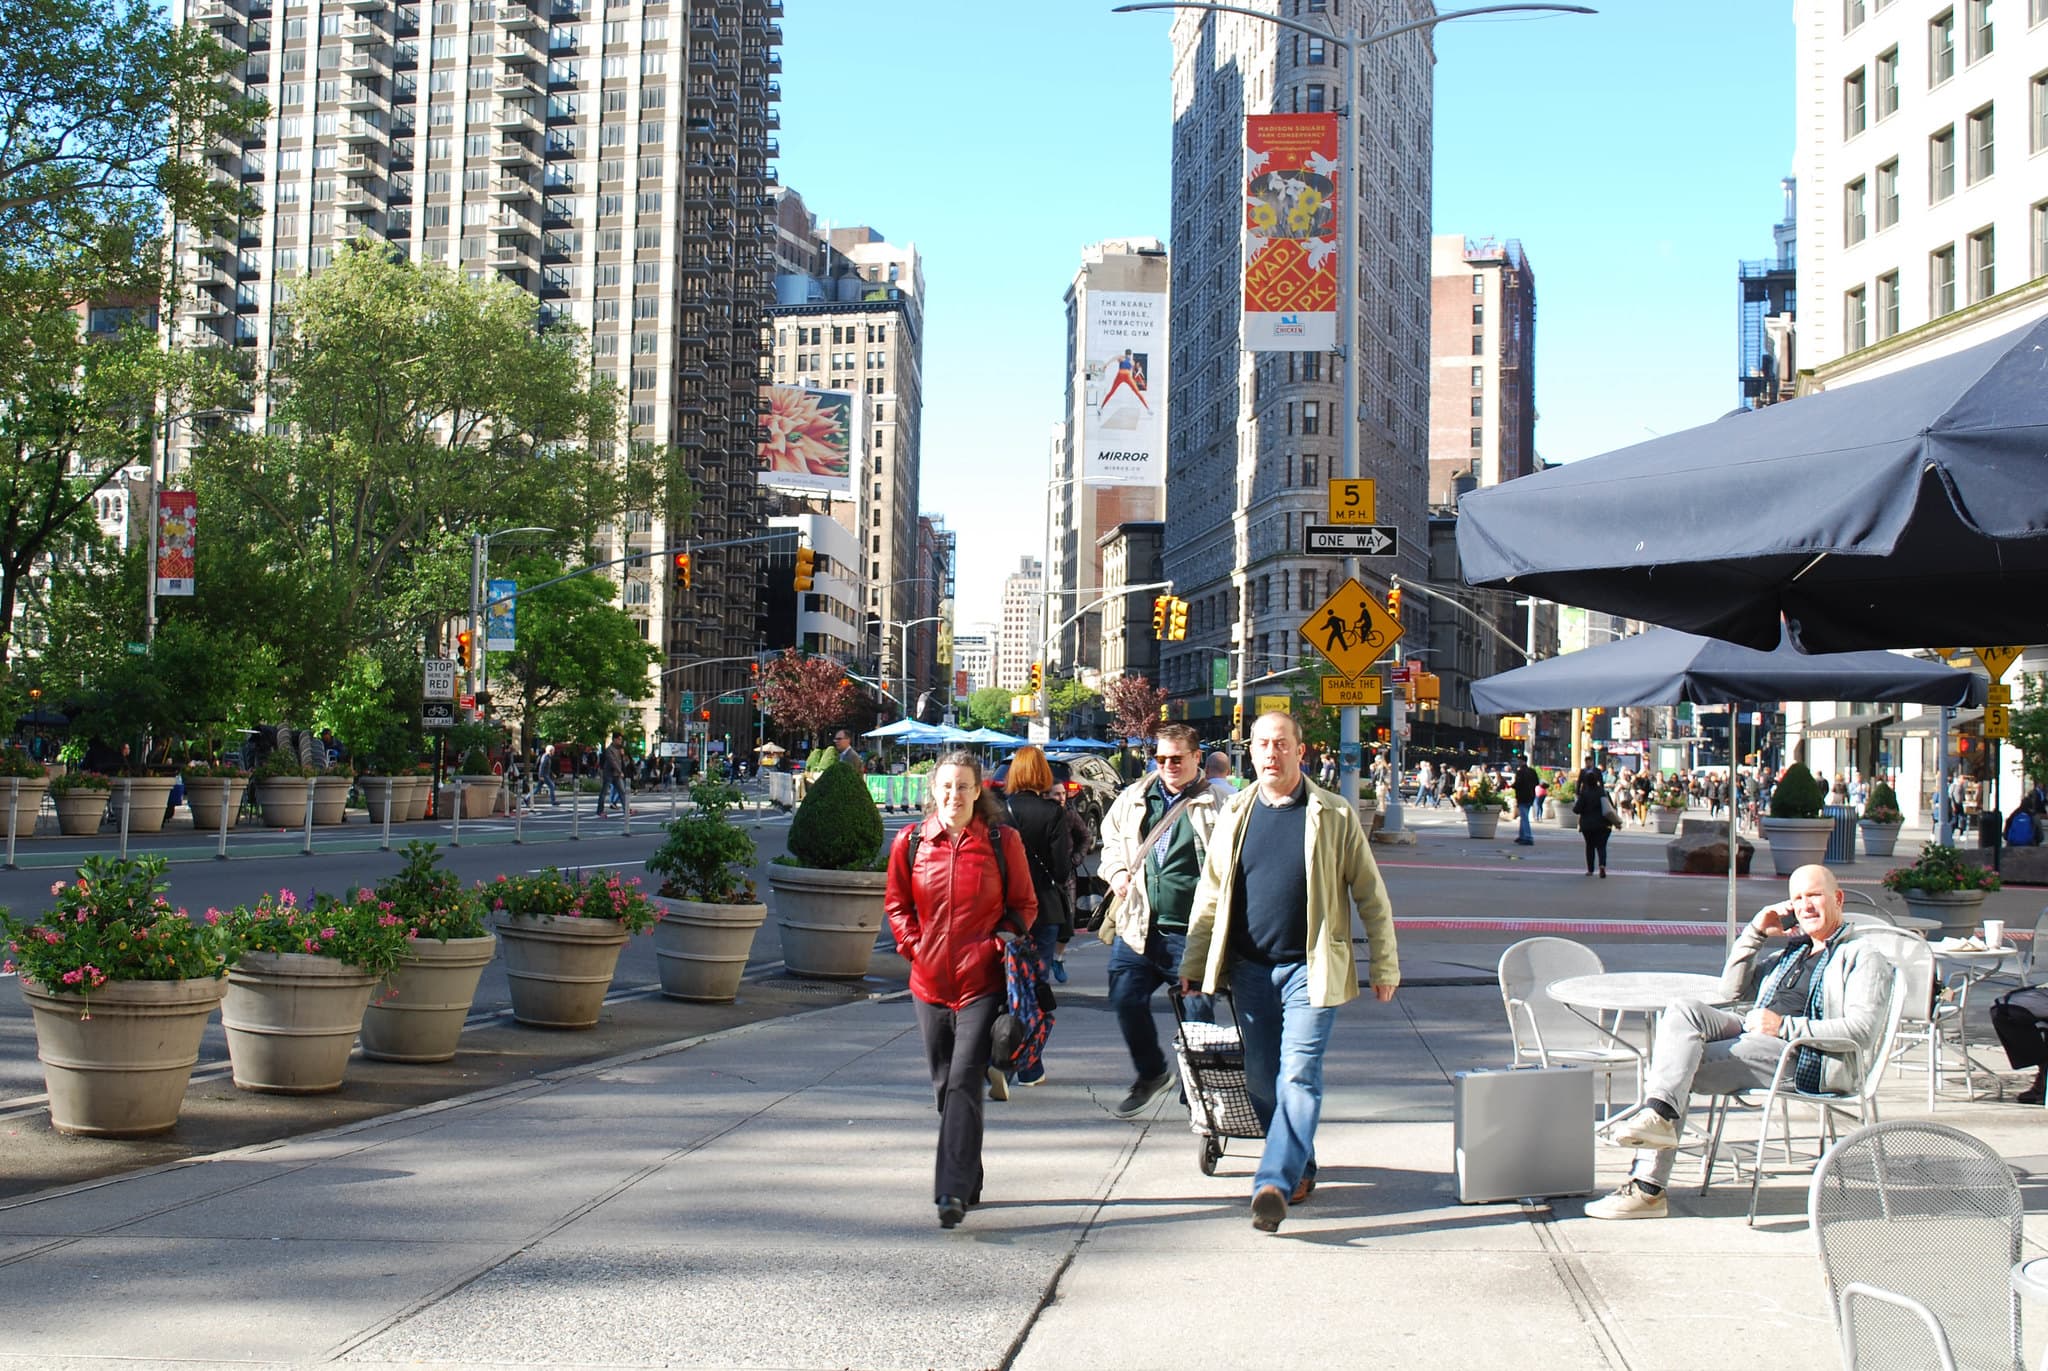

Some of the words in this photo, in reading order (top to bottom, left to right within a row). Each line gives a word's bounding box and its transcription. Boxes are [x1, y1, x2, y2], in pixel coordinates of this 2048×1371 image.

[1247, 248, 1296, 289] MAD.
[1265, 280, 1301, 307] SQ.
[1298, 283, 1333, 311] PK.
[1098, 319, 1154, 328] INTERACTIVE
[1103, 329, 1128, 337] HOME
[1097, 451, 1149, 462] MIRROR
[1344, 484, 1360, 506] 5
[1318, 534, 1345, 547] ONE
[1356, 535, 1384, 547] WAY
[426, 662, 452, 672] STOP
[429, 679, 449, 689] RED
[1328, 680, 1357, 689] SHARE
[1360, 679, 1376, 689] THE
[1339, 691, 1364, 700] ROAD
[1992, 709, 2001, 725] 5
